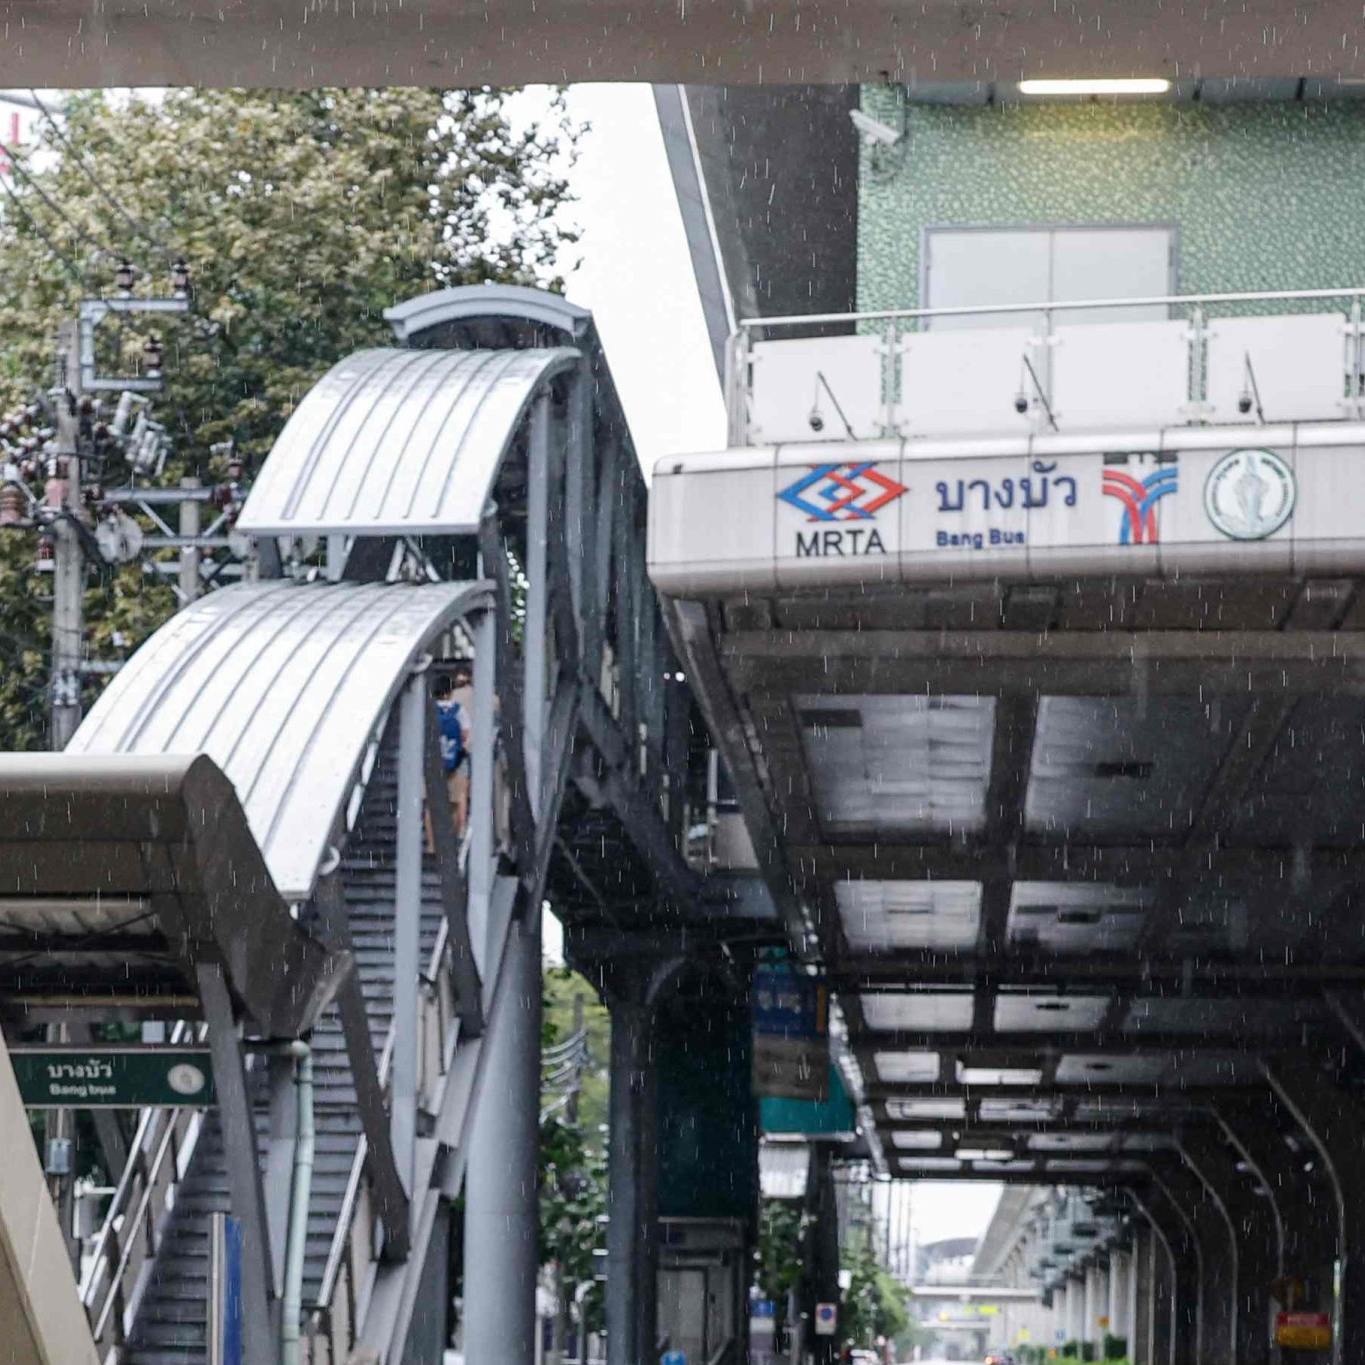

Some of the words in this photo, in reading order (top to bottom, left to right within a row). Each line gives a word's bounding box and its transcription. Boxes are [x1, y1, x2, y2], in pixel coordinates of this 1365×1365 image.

[936, 461, 1077, 512] บางบัว
[795, 529, 886, 557] MRTA
[936, 530, 983, 549] Bang
[47, 1059, 112, 1078] บางบัว
